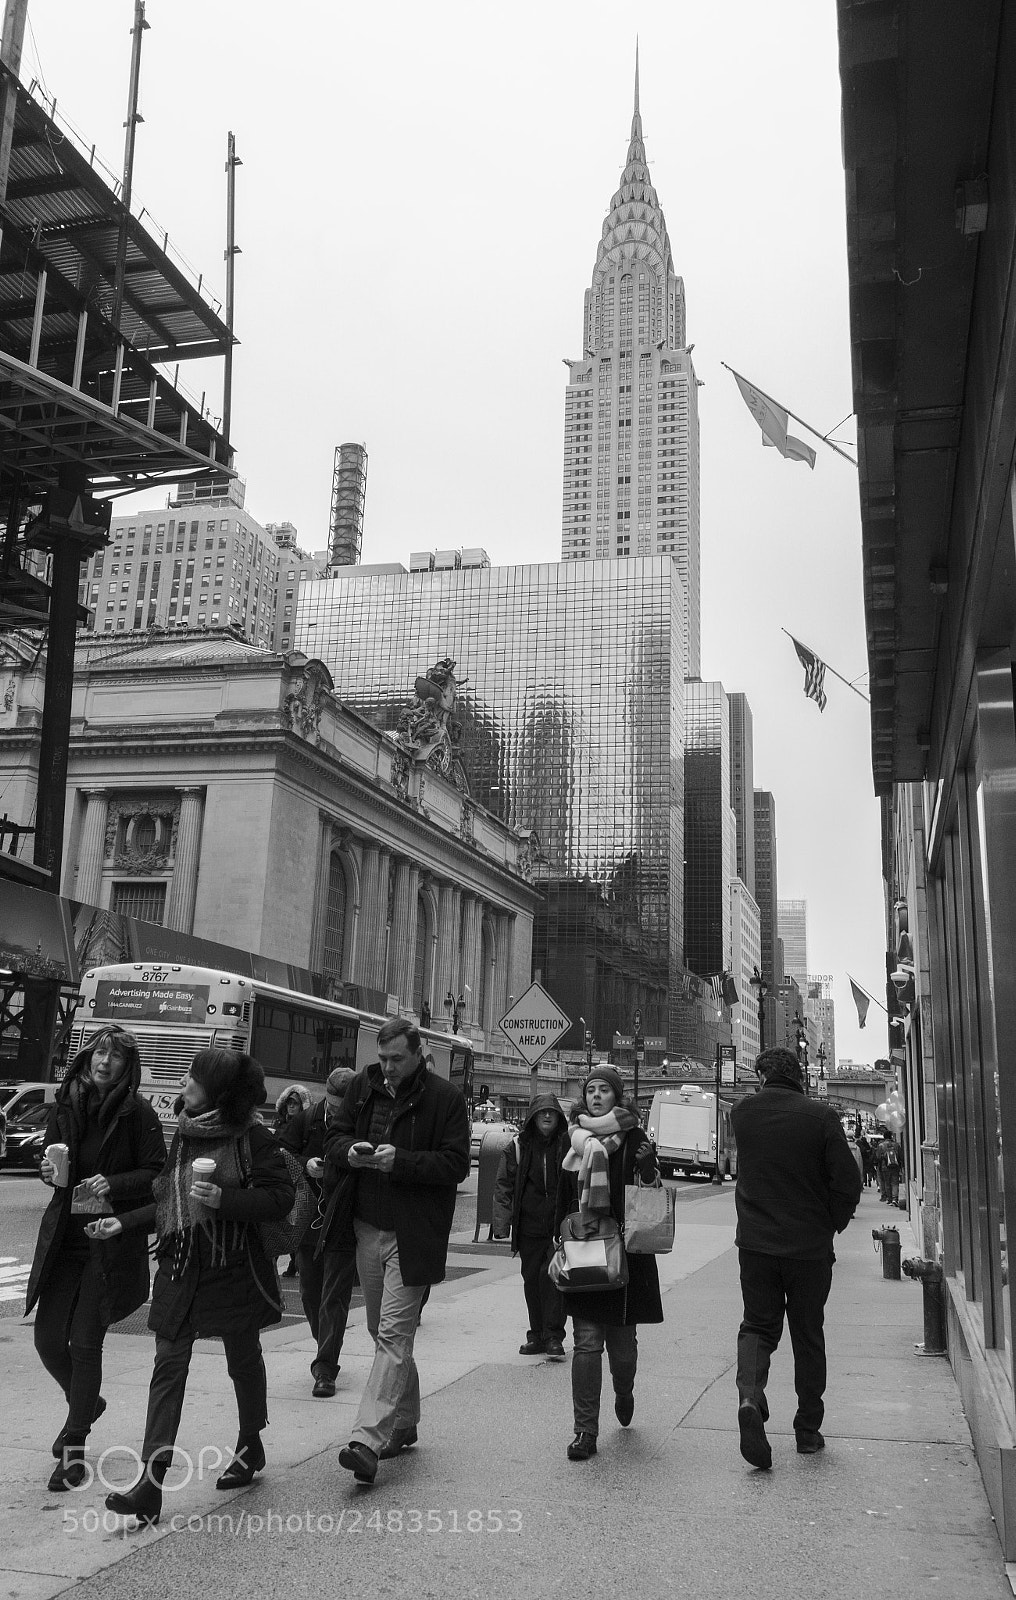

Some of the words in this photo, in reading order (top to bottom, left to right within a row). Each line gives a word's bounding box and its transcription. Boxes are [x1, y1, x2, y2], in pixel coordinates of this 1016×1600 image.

[141, 971, 169, 982] 8767
[807, 974, 834, 982] TUDOR
[109, 988, 151, 999] Advertising
[152, 990, 174, 999] Made
[175, 991, 195, 1002] Easy.
[503, 1019, 564, 1030] CONSTRUCTION
[518, 1035, 547, 1046] AHEAD
